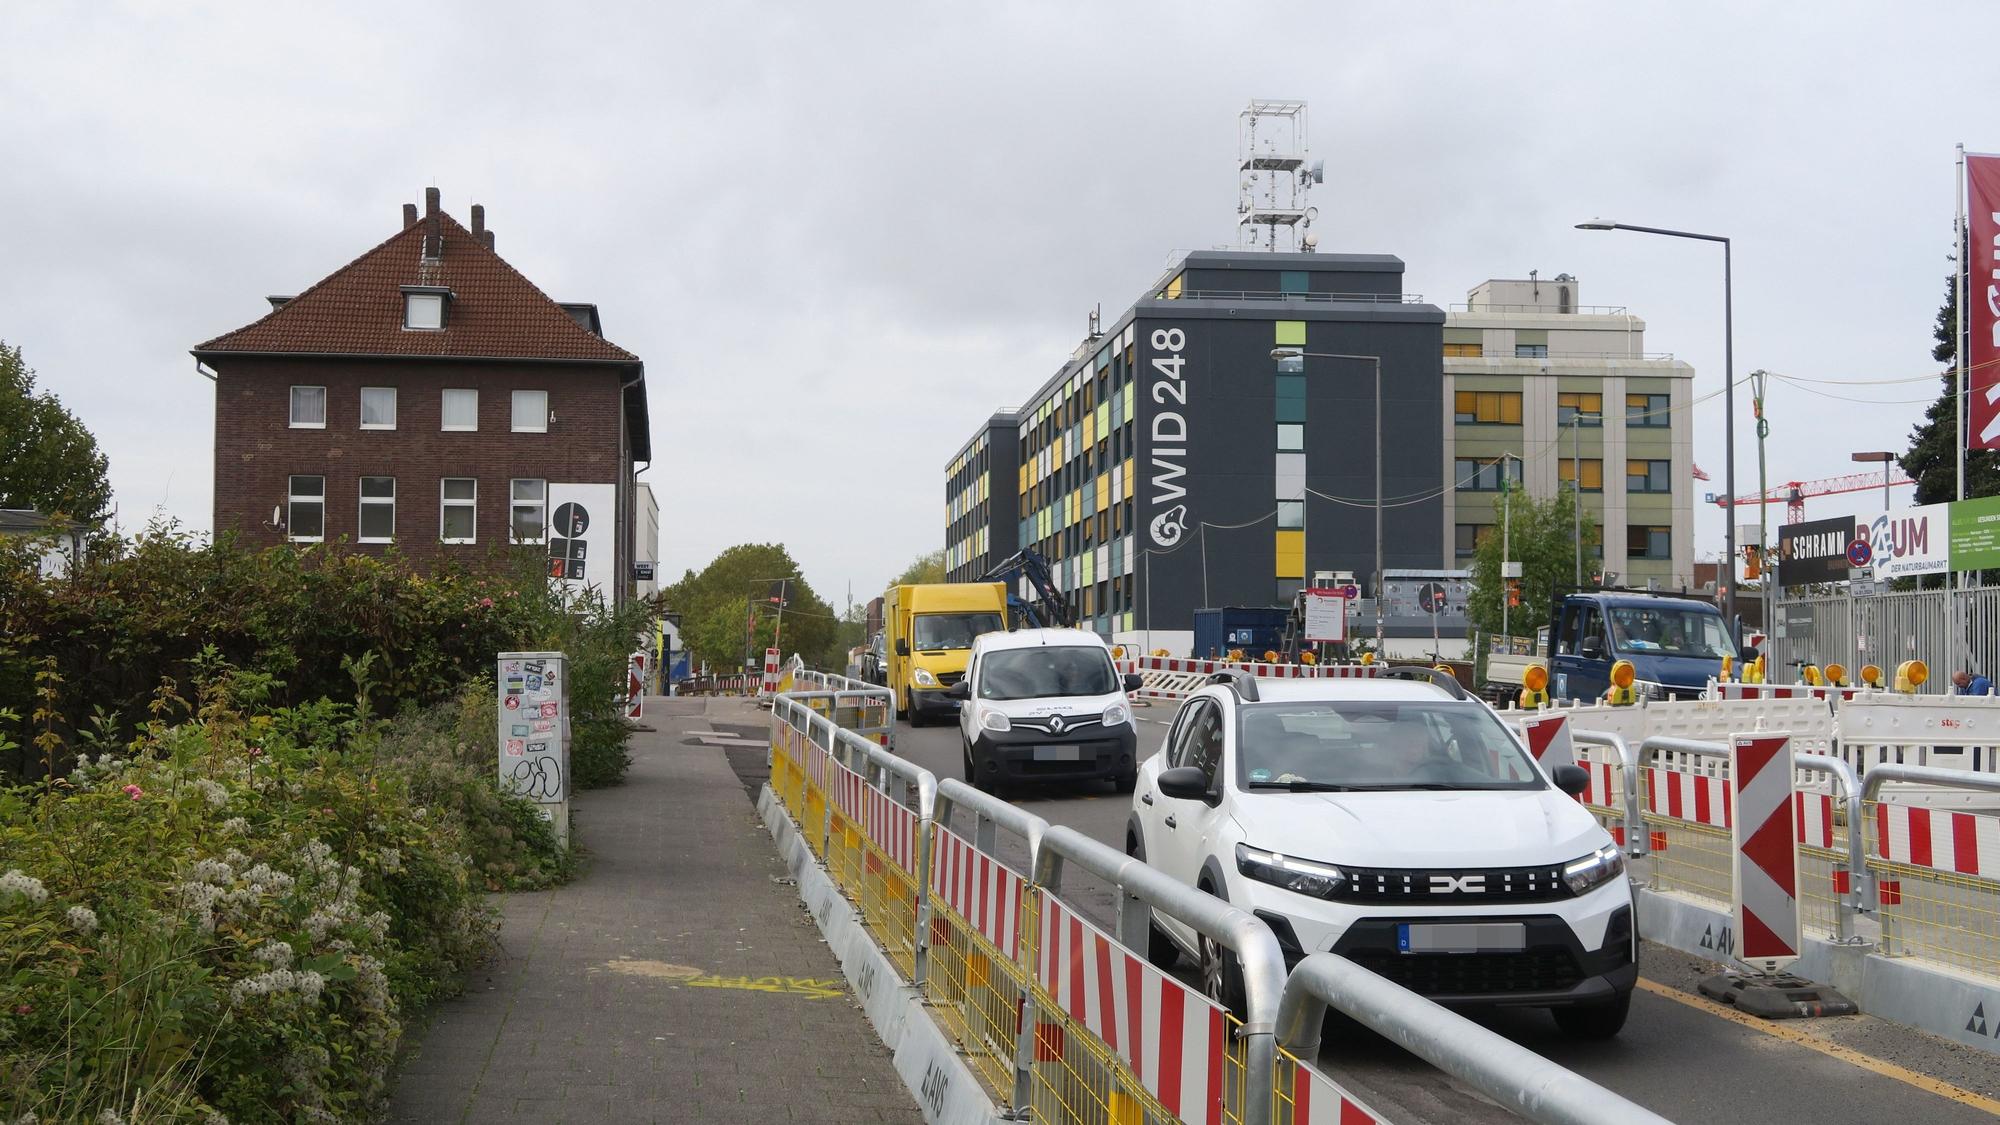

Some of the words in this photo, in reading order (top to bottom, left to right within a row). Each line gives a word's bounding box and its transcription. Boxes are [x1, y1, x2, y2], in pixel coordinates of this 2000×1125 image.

[1151, 327, 1187, 405] 248
[1151, 411, 1187, 505] WID
[1793, 530, 1845, 560] SCHRAMM
[1716, 926, 1735, 956] AV
[927, 1066, 949, 1119] AVS
